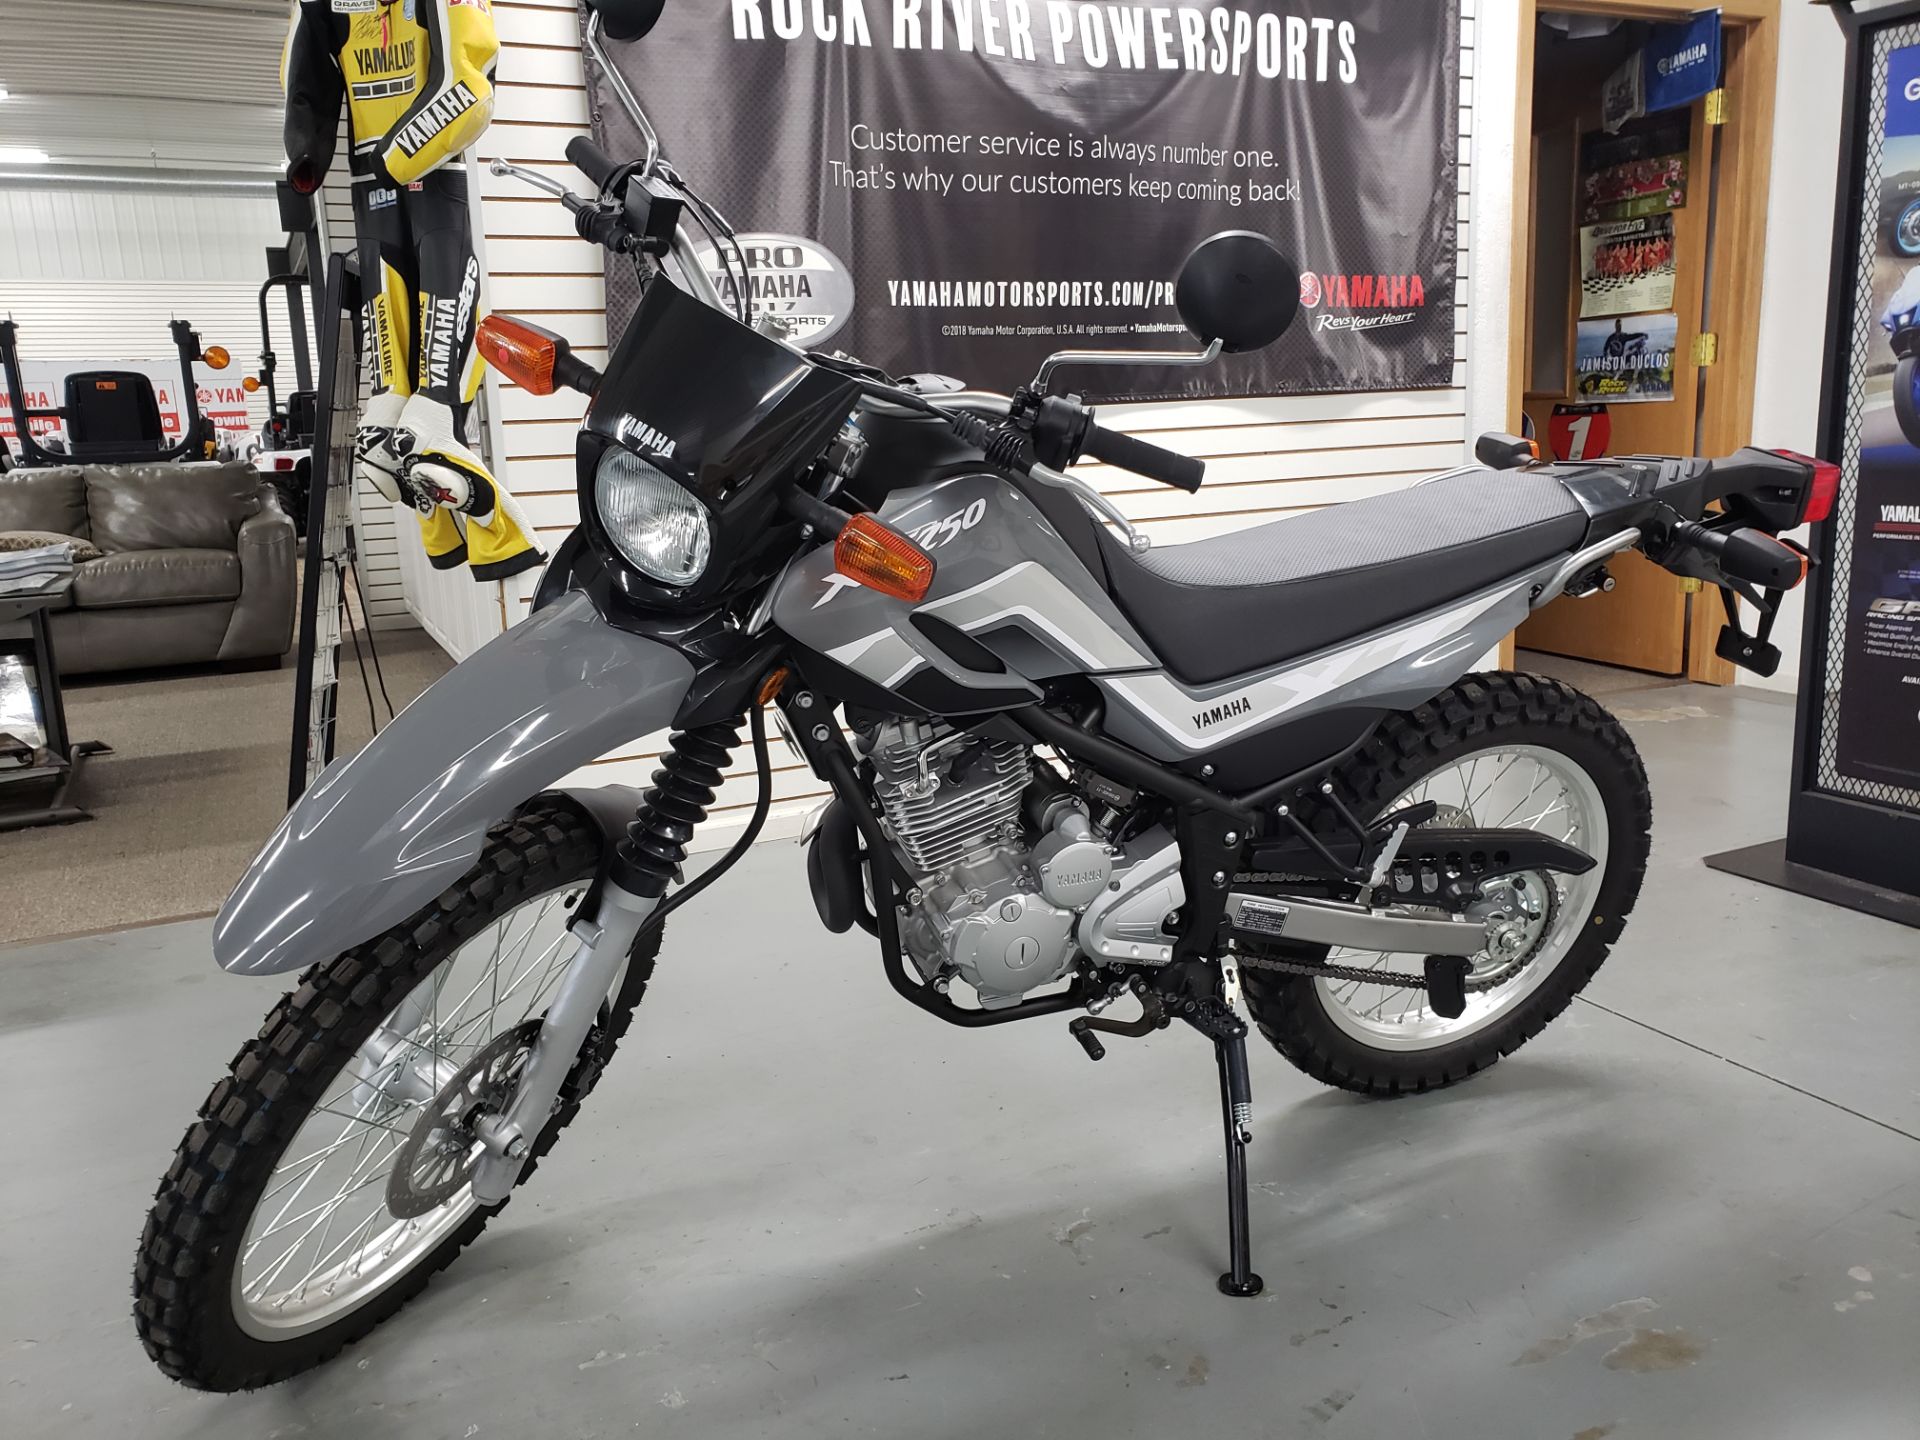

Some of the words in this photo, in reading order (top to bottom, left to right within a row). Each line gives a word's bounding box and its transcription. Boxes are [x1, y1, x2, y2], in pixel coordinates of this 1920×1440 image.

[731, 0, 872, 47] ROCK
[893, 0, 1036, 61] RIVER
[1047, 1, 1358, 84] POWERSPORTS
[395, 82, 478, 155] YAMAHA
[851, 124, 972, 154] Customer
[979, 131, 1060, 156] service
[1068, 133, 1084, 158] is
[1091, 134, 1156, 166] always
[1162, 142, 1229, 166] number
[1233, 149, 1279, 168] one.
[829, 160, 896, 190] That's
[903, 166, 954, 197] why
[962, 173, 1003, 193] our
[1010, 171, 1122, 196] customers
[1129, 173, 1172, 203] keep
[1177, 179, 1242, 206] coming
[1249, 178, 1301, 202] back!
[717, 246, 804, 270] PRO
[1322, 274, 1425, 308] YAMAHA
[431, 299, 457, 388] YAMAHA
[967, 325, 994, 336] Yamaha
[995, 325, 1016, 336] Motor
[1017, 324, 1055, 338] Corporation,
[1056, 324, 1075, 335] U.S.A.
[1076, 324, 1085, 334] All
[1086, 323, 1104, 336] rights
[1580, 356, 1626, 372] JAMISON
[1631, 352, 1670, 370] DUCLOS
[619, 413, 677, 459] YAMAHA
[1568, 416, 1592, 460] 1
[1866, 611, 1905, 620] RACING
[1192, 697, 1252, 730] YAMAHA
[1056, 868, 1103, 888] YAMAHA
